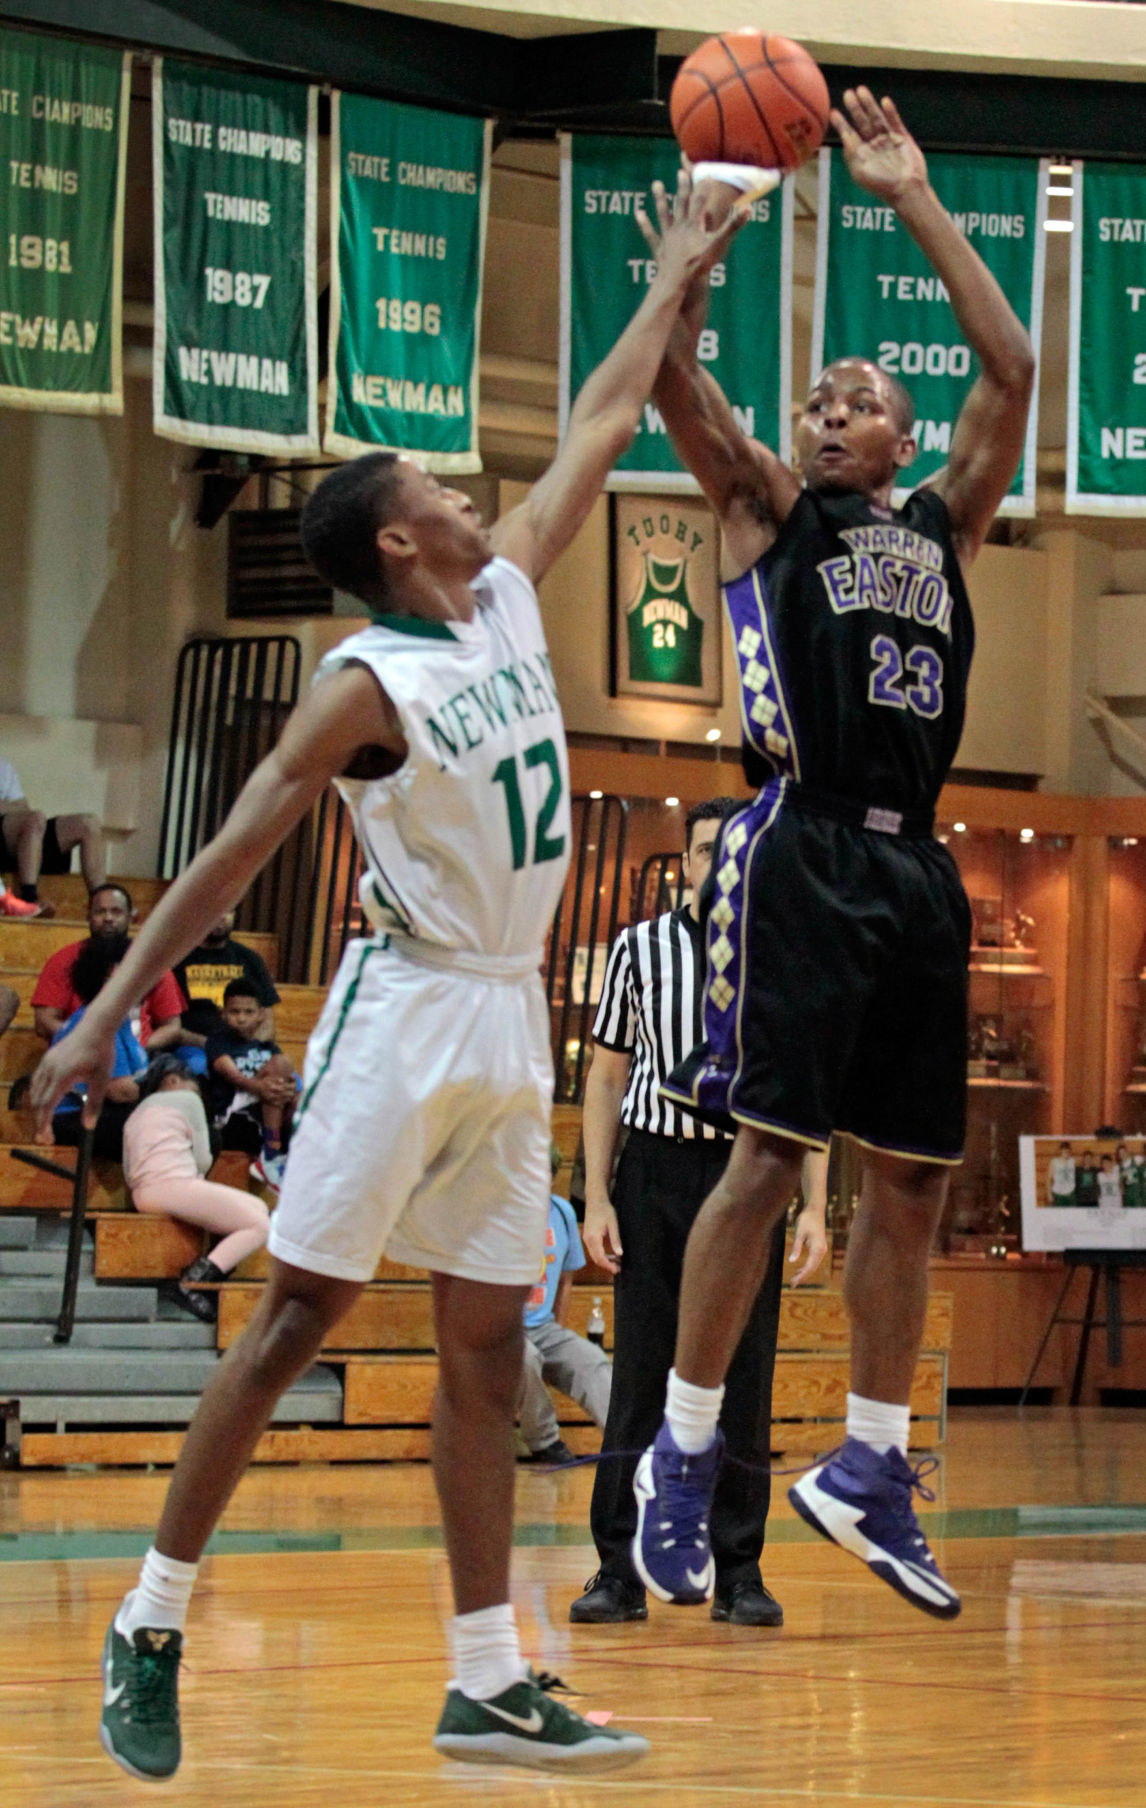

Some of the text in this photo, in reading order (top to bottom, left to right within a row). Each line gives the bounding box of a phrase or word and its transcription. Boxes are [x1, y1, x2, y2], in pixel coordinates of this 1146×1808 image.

[168, 117, 303, 164] STATE CHAMPIONS
[347, 151, 477, 195] STATE CHAMPIONS
[204, 191, 271, 227] TENNIS
[584, 189, 646, 214] STATE
[841, 204, 1025, 239] STATE MPIONS
[371, 226, 447, 261] TENNIS
[1098, 216, 1146, 244] STAT
[8, 233, 73, 275] 1981
[204, 266, 272, 310] 1987
[876, 274, 951, 304] TENN
[0, 311, 99, 355] EWMAN
[375, 296, 443, 338] 1996
[177, 345, 290, 397] NEWMAN
[877, 340, 971, 377] 2000
[351, 371, 466, 417] NEWMAN
[626, 513, 704, 553] TUOHY
[837, 524, 945, 573] WARREN
[652, 622, 677, 649] 24
[868, 633, 945, 720] 23
[491, 737, 566, 872] 12
